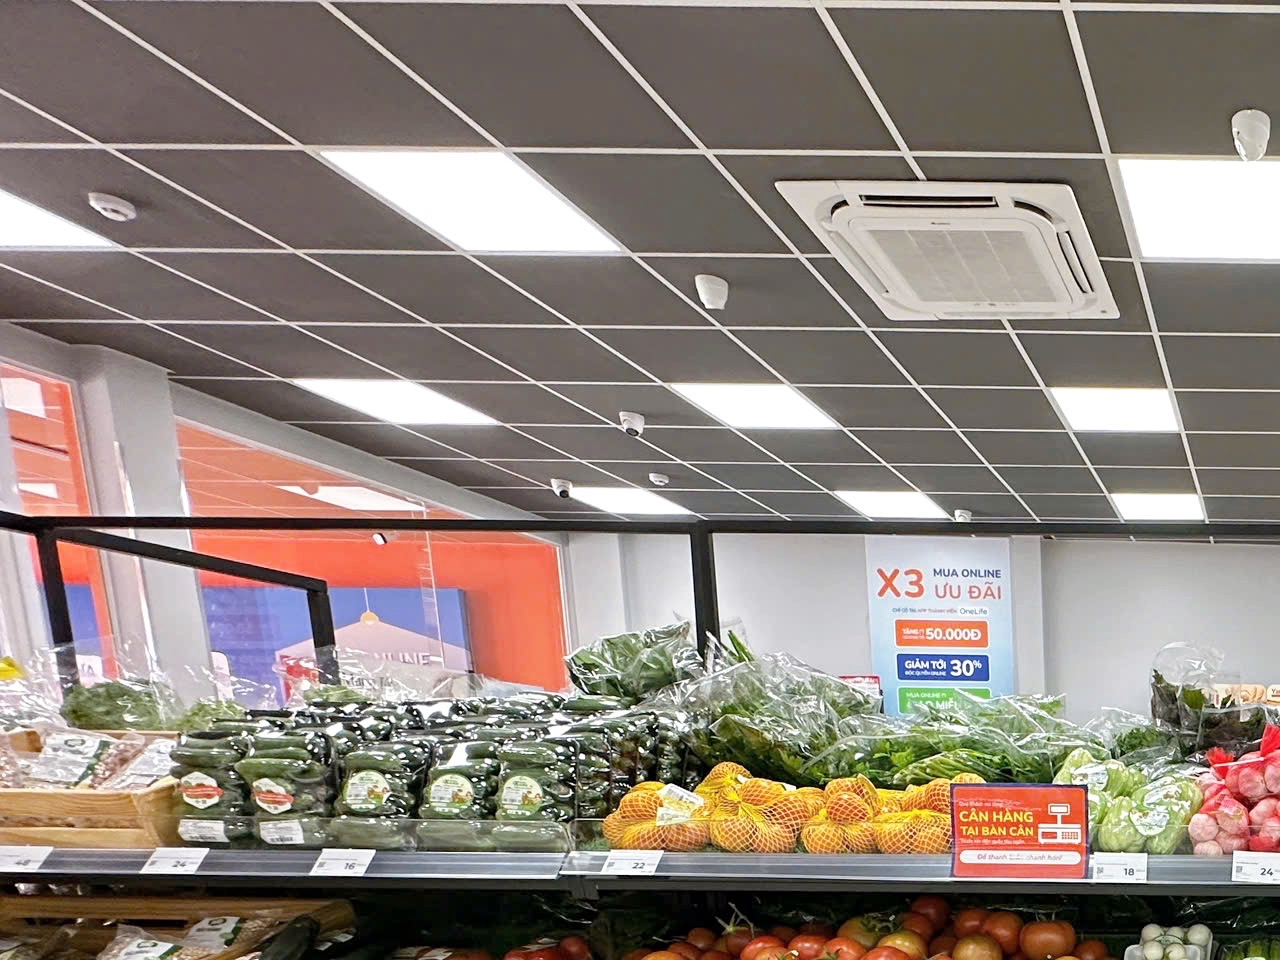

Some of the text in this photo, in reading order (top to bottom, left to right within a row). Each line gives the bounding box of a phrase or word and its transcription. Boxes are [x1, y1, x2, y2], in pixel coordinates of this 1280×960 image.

[933, 568, 1002, 578] MUA ONLINE
[877, 568, 925, 598] X3
[935, 582, 1002, 600] ƯU ĐÃI
[926, 628, 981, 640] 50.000Đ
[905, 658, 982, 677] GIẢM TỚI 30%
[960, 807, 1034, 823] CÂN HÀNG
[960, 823, 1034, 839] TẠI BÀN CÂN
[344, 862, 356, 871] 16
[632, 862, 646, 870] 22
[1124, 867, 1135, 876] 18
[1260, 868, 1274, 876] 24
